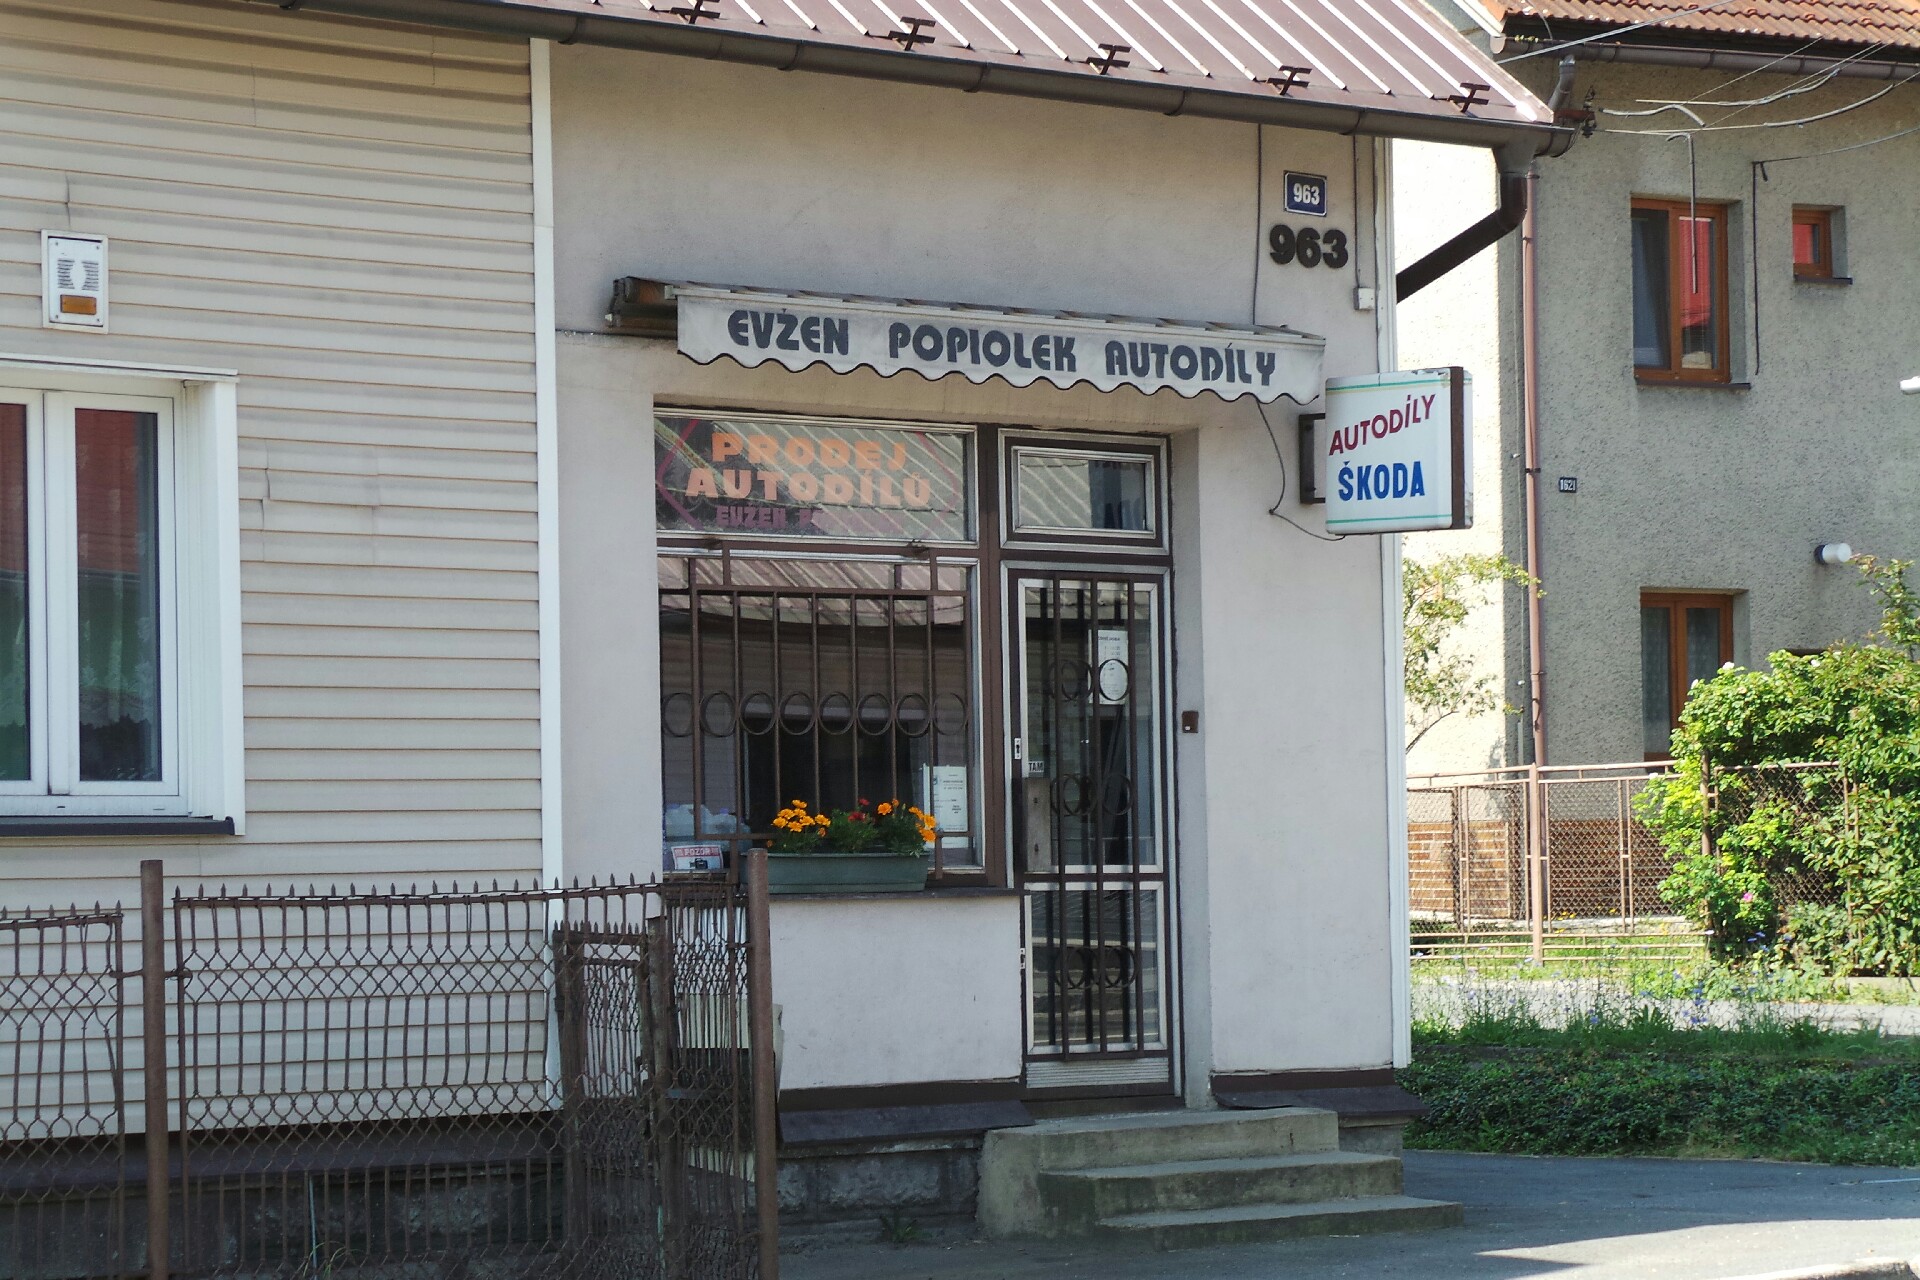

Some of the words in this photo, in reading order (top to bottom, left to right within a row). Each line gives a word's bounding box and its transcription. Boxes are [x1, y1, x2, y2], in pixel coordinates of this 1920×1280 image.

[1293, 183, 1320, 205] 963
[1269, 224, 1349, 269] 963
[727, 308, 849, 355] EVŽEN
[888, 321, 1077, 373] POPIOLEK
[1105, 340, 1276, 387] AUTODÍLY
[1328, 394, 1436, 456] AUTODÍLY
[711, 432, 906, 471] PRODEJ
[685, 467, 931, 507] AUTODÍLŮ
[1338, 460, 1425, 501] ŠKODA
[684, 847, 710, 856] POZOR
